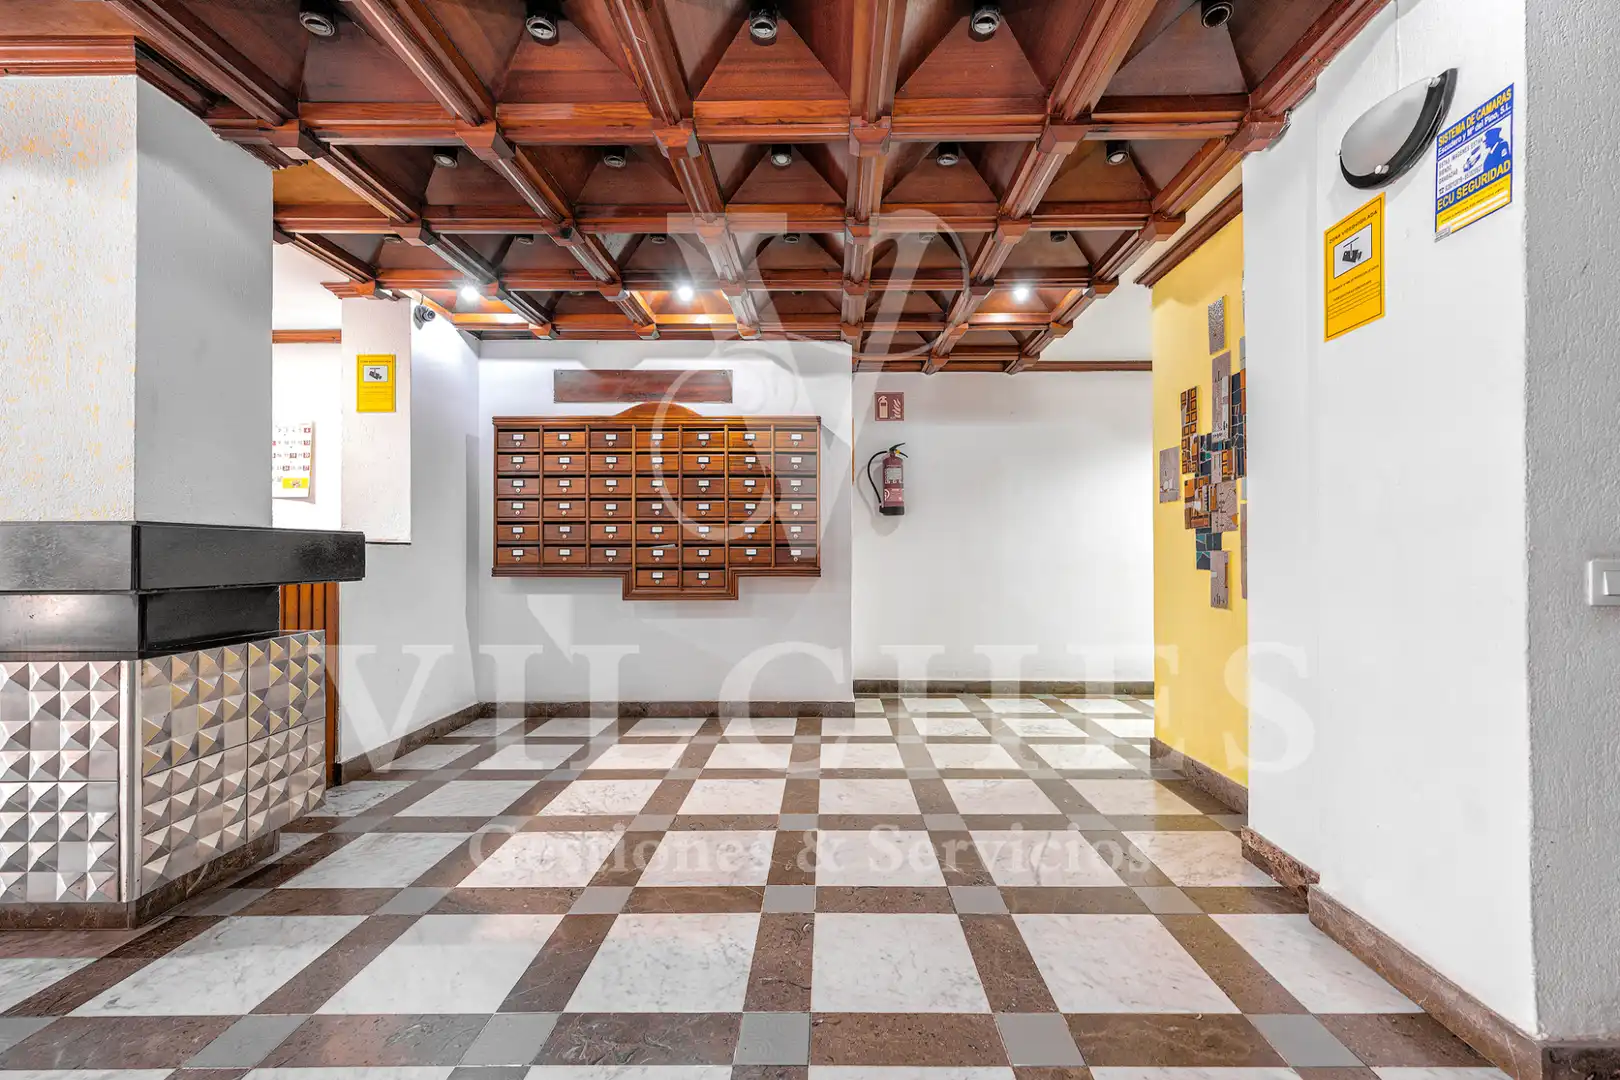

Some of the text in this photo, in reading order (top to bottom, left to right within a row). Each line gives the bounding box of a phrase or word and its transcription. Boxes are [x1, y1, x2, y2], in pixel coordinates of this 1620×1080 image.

[1438, 88, 1512, 147] SISTEMA DE CAMARAS
[1437, 191, 1456, 211] ECU
[1455, 159, 1511, 200] SEGURIDAD
